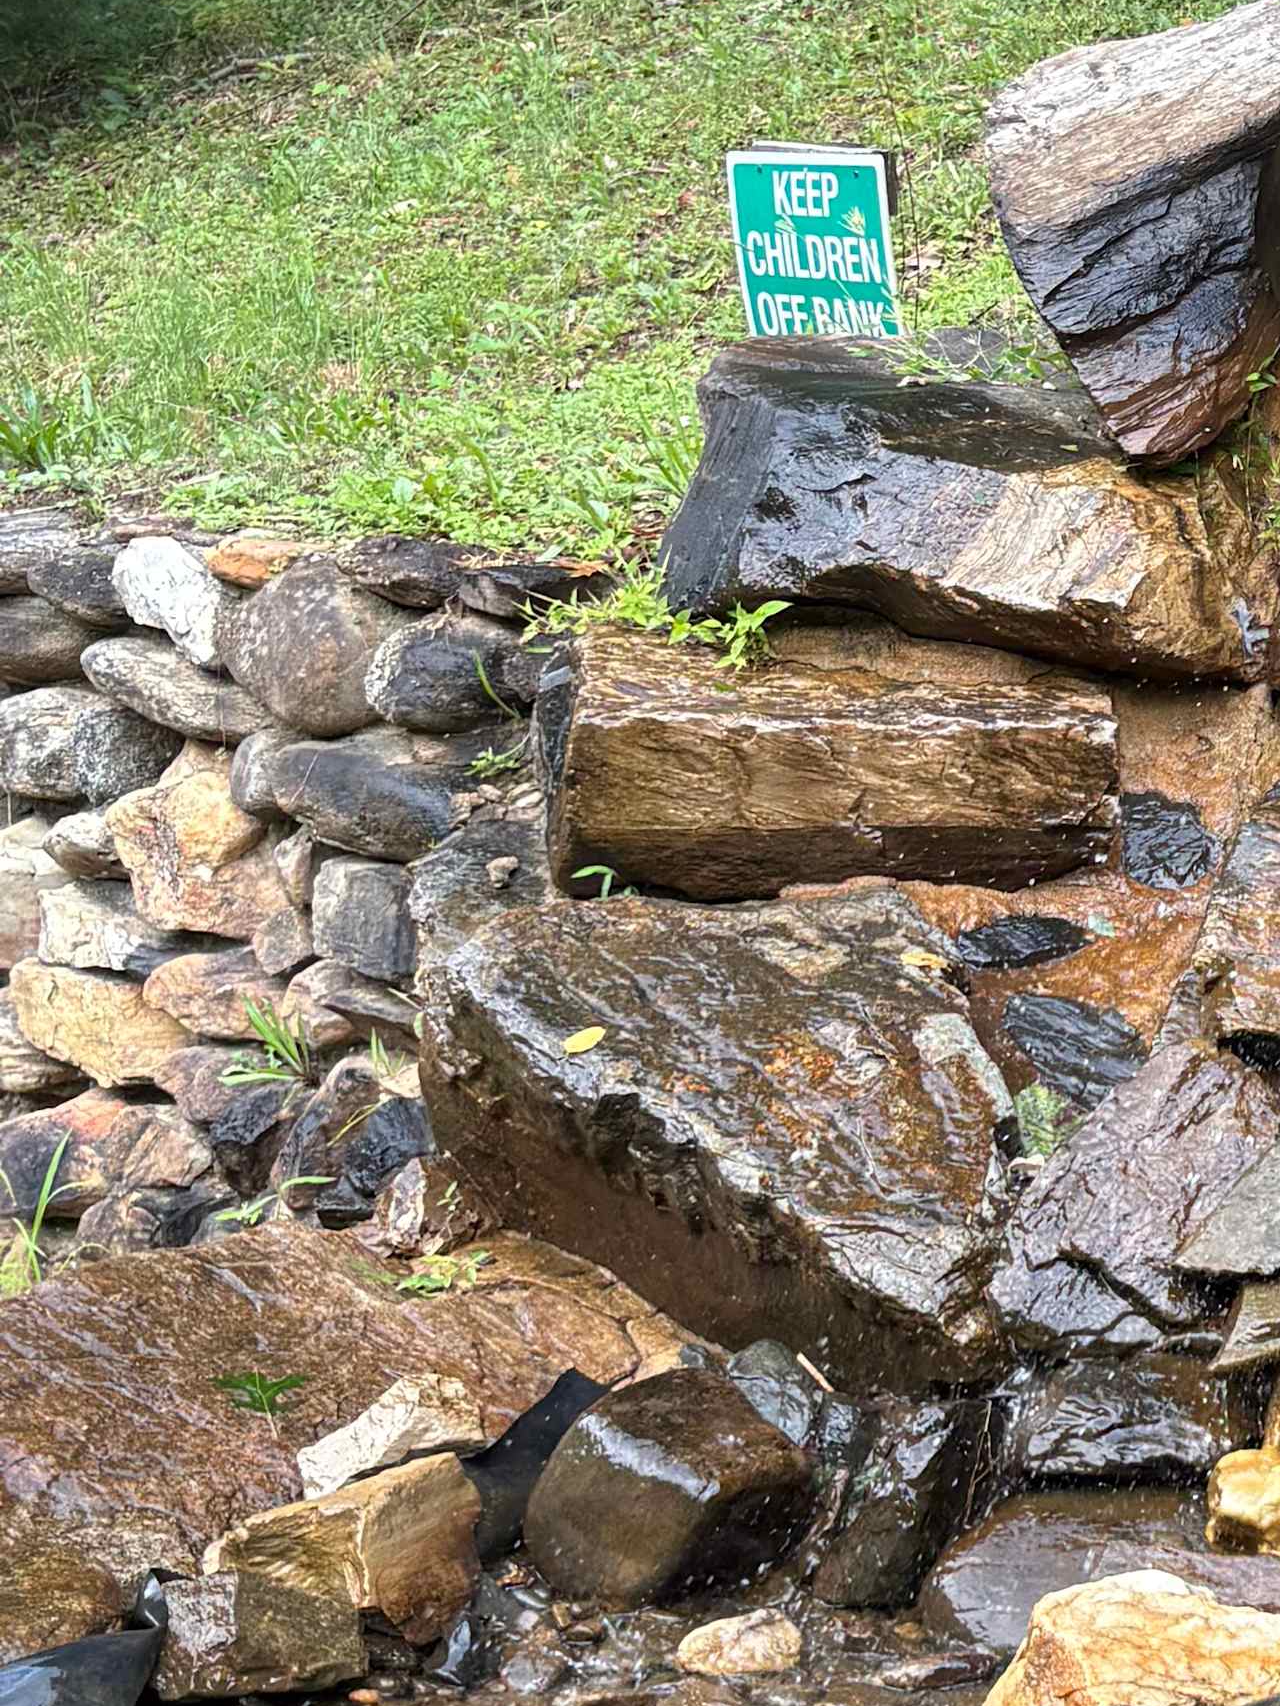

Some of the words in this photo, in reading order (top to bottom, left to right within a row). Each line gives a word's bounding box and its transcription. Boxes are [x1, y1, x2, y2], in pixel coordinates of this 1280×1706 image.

[772, 170, 839, 218] KEEP
[746, 230, 882, 284] CHILDREN
[757, 291, 808, 336] OFF
[812, 296, 885, 337] BANK
